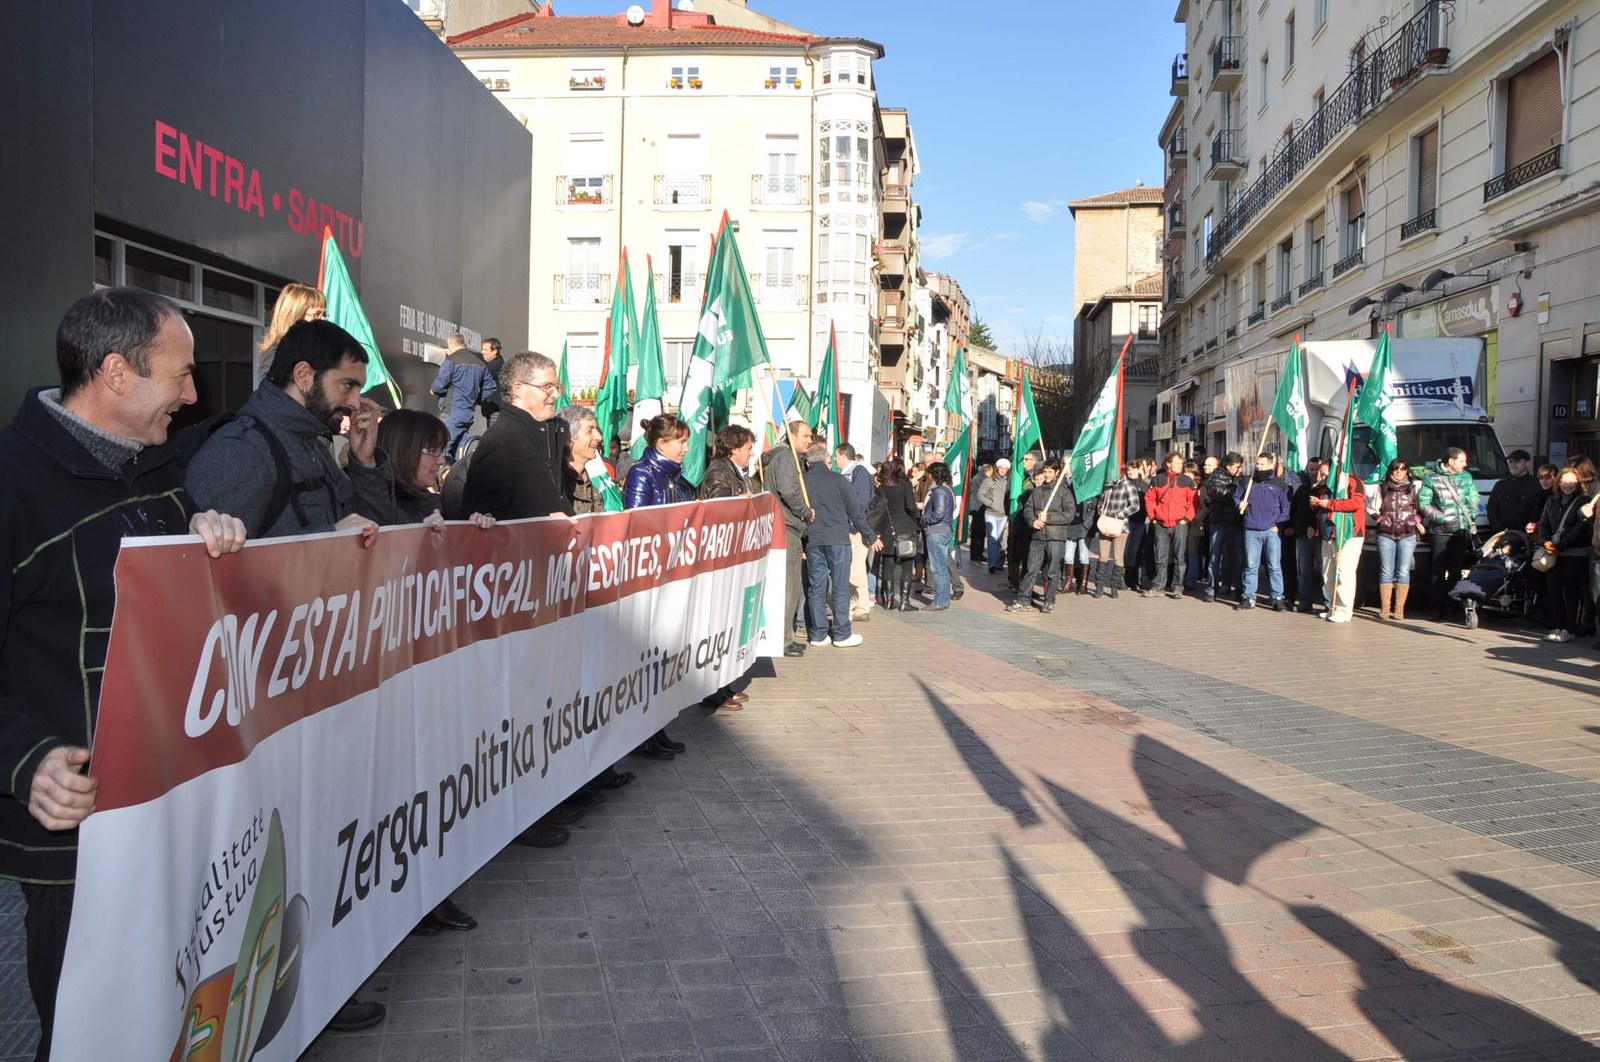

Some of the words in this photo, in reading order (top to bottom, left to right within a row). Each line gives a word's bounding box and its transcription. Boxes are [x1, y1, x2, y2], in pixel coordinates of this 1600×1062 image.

[155, 119, 265, 219] ENTRA
[288, 187, 363, 259] SARTU
[400, 304, 416, 331] FERIA
[417, 310, 425, 334] DE
[425, 313, 436, 338] LOS
[1554, 405, 1567, 418] 10
[267, 588, 361, 698] ESTA
[452, 557, 540, 627] FISCAL,
[545, 537, 586, 608] MÁS
[697, 521, 736, 562] PARO
[733, 520, 745, 556] Y
[331, 791, 429, 929] Zerga
[438, 717, 536, 859] politika
[540, 688, 614, 779] justua
[614, 645, 692, 716] exijitzen
[195, 857, 258, 983] justua
